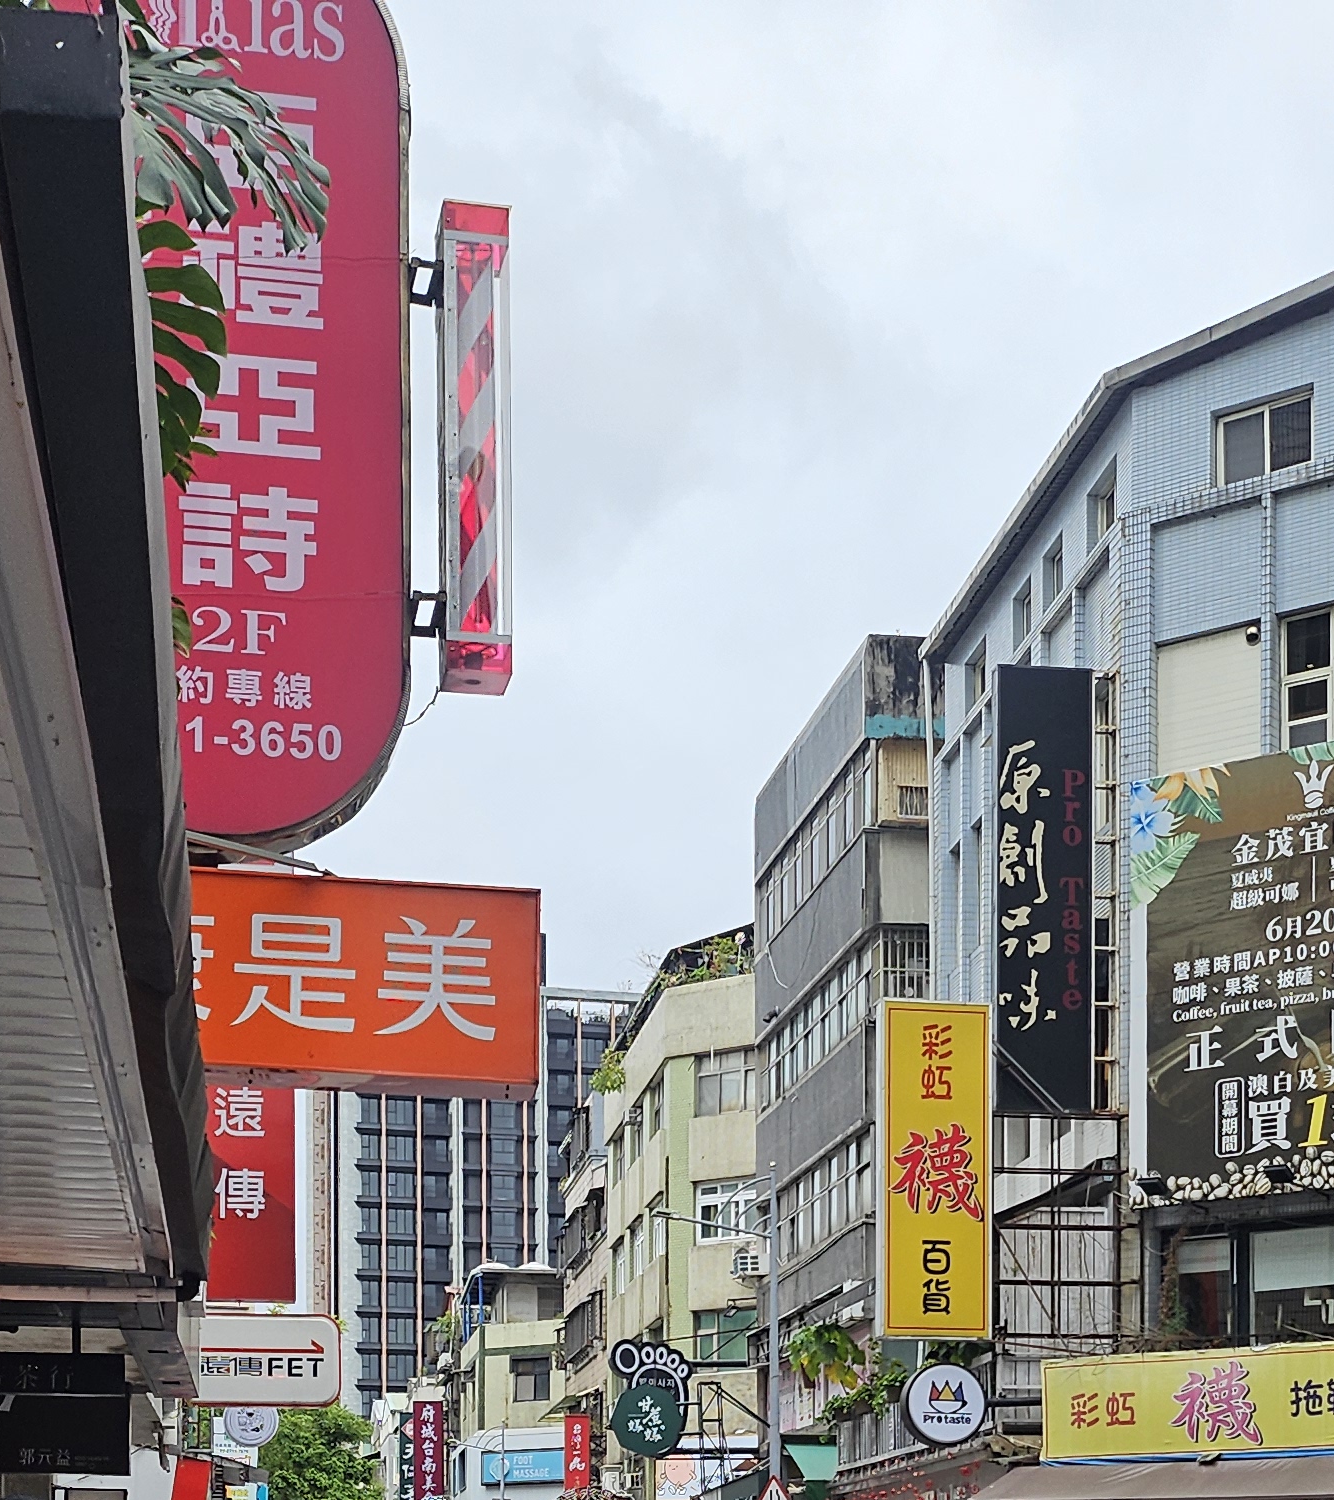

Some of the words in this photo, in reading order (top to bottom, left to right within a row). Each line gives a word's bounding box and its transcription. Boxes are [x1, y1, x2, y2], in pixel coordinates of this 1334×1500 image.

[191, 605, 288, 656] 2F
[176, 665, 313, 710] 約專線
[184, 715, 343, 762] 1-3650
[1061, 768, 1085, 847] Pro
[999, 739, 1057, 1031] 原創品味
[1230, 867, 1274, 889] 夏威夷
[1230, 881, 1300, 911] 超級可娜
[1059, 876, 1085, 1011] Taste
[921, 1024, 953, 1100] 彩虹
[214, 1086, 266, 1220] 遠傳
[1221, 1082, 1238, 1153] 開幕期間
[888, 1123, 985, 1222] 襪
[921, 1239, 952, 1317] 百貨
[267, 1357, 324, 1378] FET
[1070, 1391, 1136, 1429] 彩虹
[1170, 1359, 1264, 1447] 襪
[19, 1448, 71, 1467] 郭元益
[420, 1403, 438, 1496] 府城台南美
[513, 1455, 534, 1465] FOOT
[513, 1467, 550, 1478] MASSAGE
